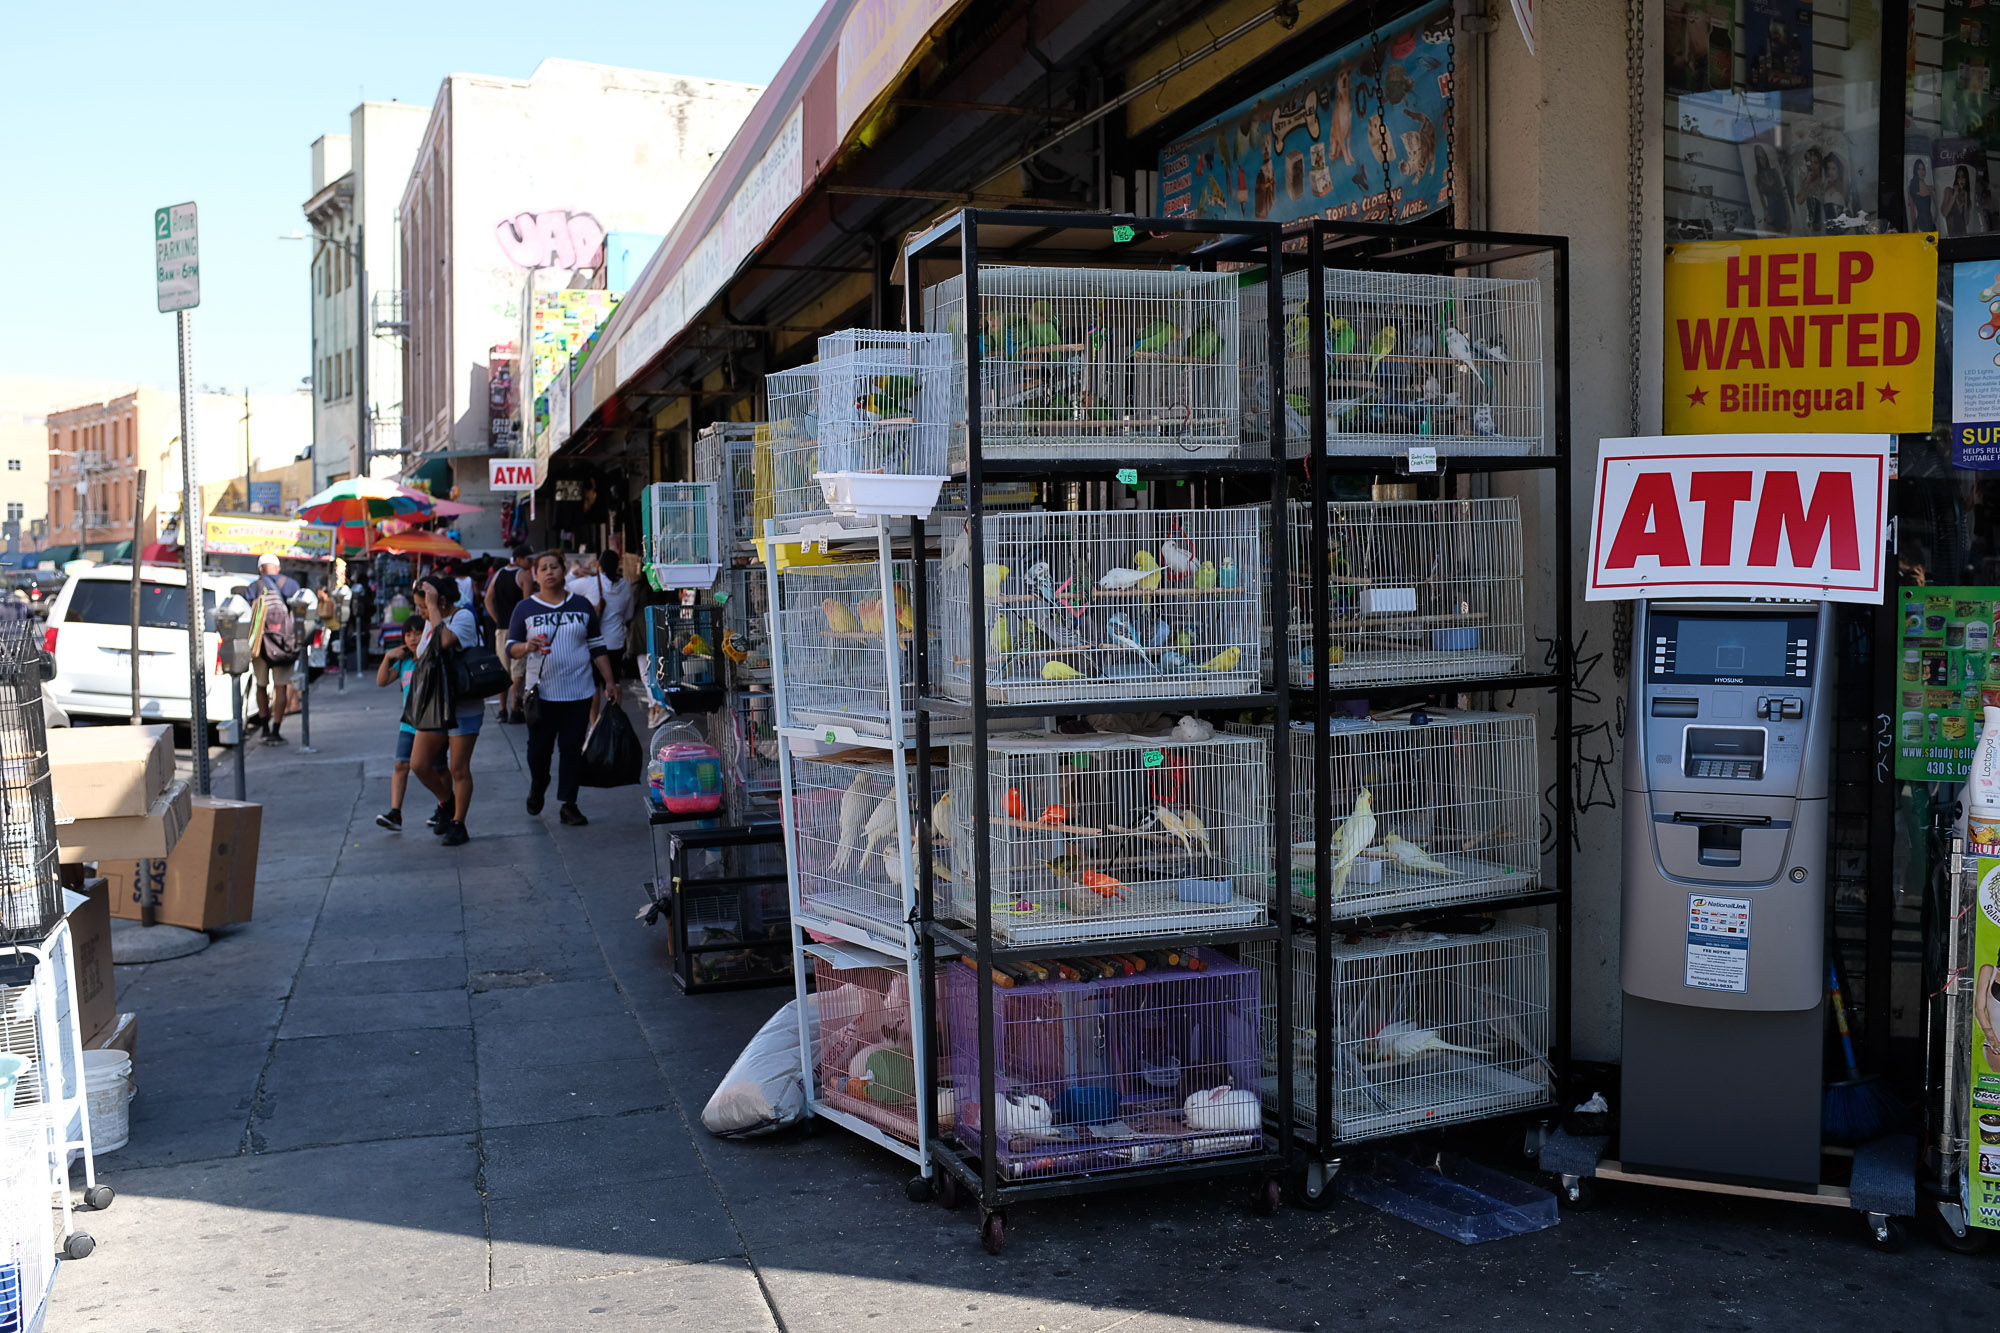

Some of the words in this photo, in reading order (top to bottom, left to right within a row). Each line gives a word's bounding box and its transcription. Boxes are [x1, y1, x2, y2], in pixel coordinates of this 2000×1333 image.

[1325, 204, 1348, 221] TOYS
[1351, 200, 1359, 216] &
[158, 212, 169, 236] 2
[173, 213, 195, 232] HOUR
[158, 237, 197, 262] PARKING
[159, 266, 175, 283] 8AM
[182, 263, 198, 279] 6PM
[1727, 250, 1875, 308] HELP
[1677, 312, 1921, 371] WANTED
[1719, 382, 1865, 419] Bilingual
[494, 466, 533, 484] ATM
[1604, 470, 1861, 571] ATM
[533, 613, 585, 628] BKLYN
[1926, 761, 1945, 775] 430
[1946, 762, 1956, 775] S.
[1982, 738, 1996, 777] Lactacyd
[1707, 900, 1747, 910] NationalLink
